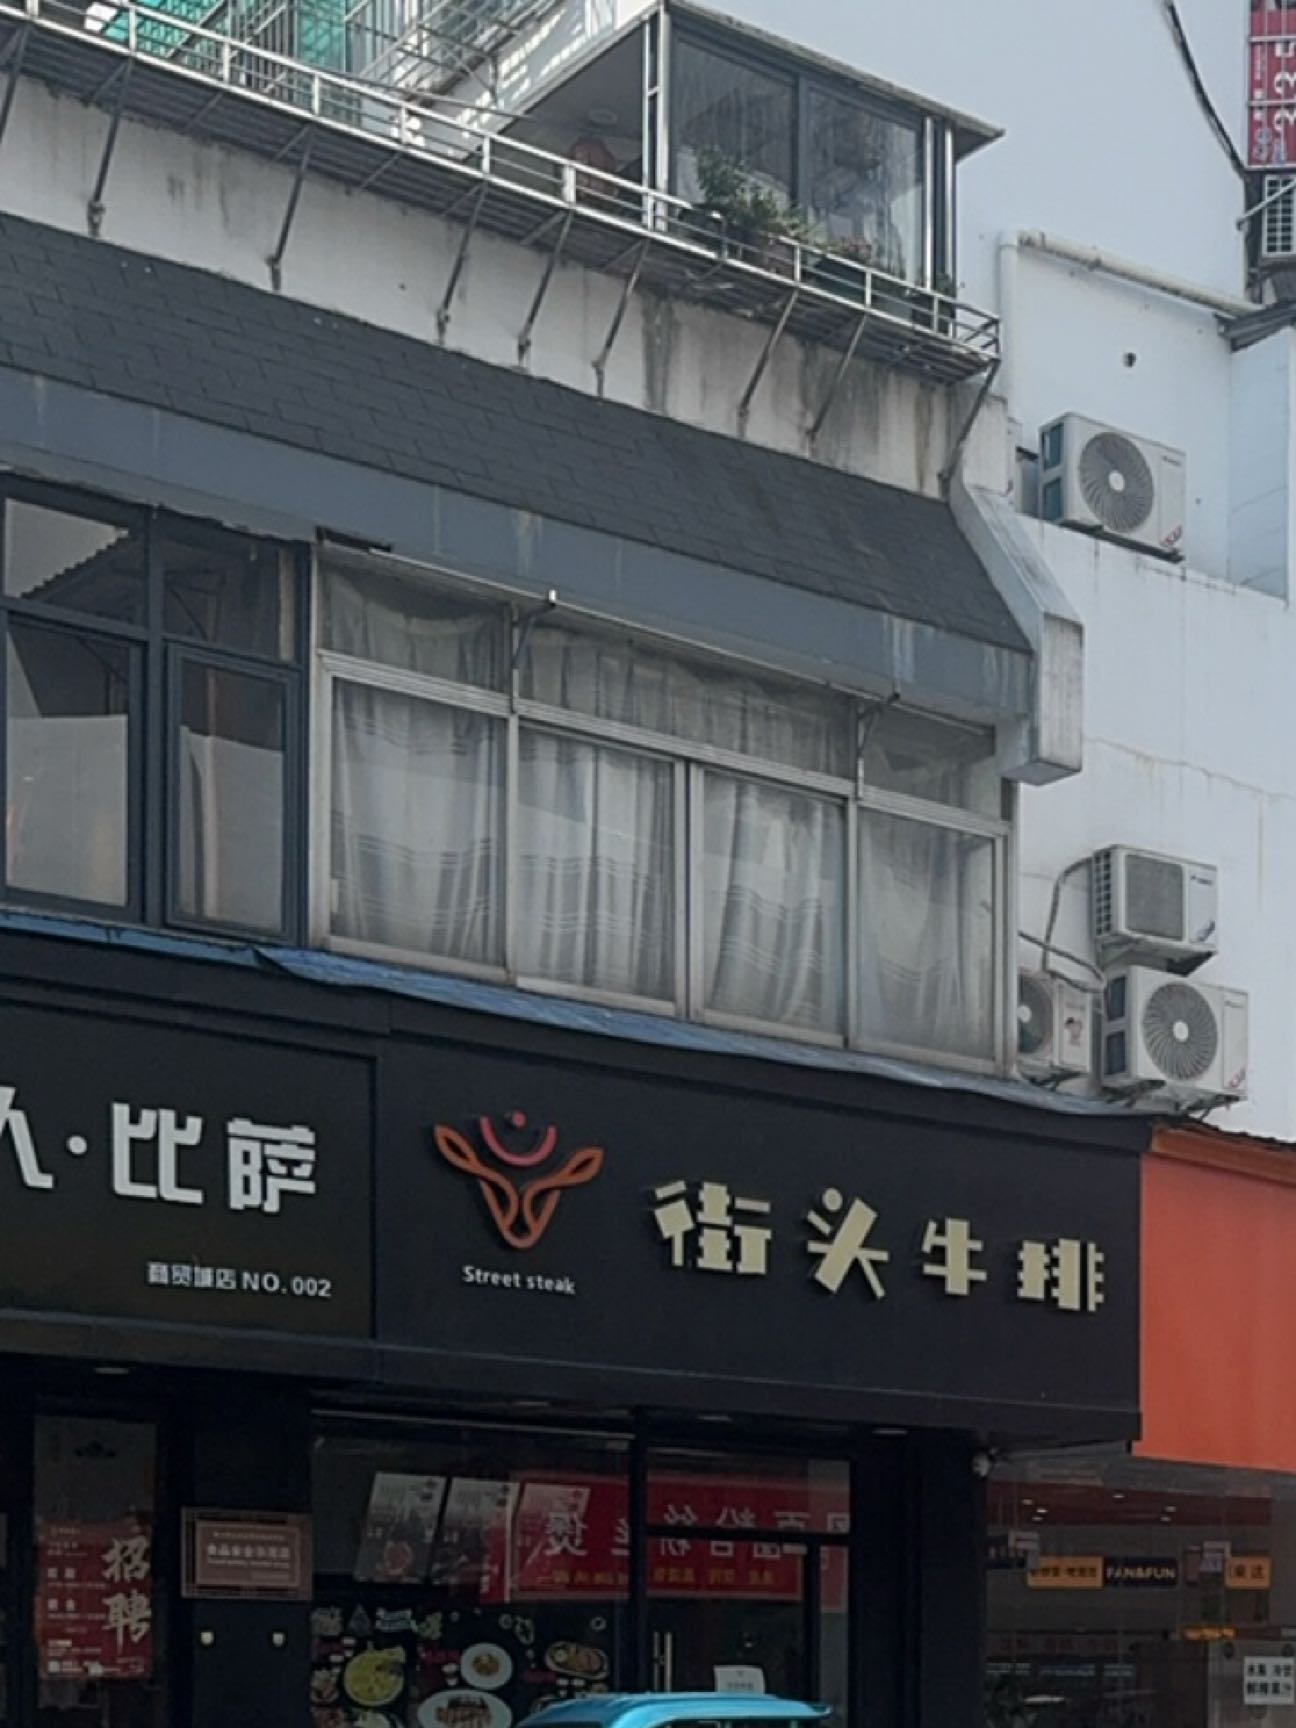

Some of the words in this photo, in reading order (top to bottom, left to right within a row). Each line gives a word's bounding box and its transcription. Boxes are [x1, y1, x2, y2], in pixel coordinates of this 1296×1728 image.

[462, 1264, 521, 1290] Street
[526, 1271, 576, 1295] steak
[653, 1180, 1104, 1312] 街头牛排
[101, 1535, 152, 1655] 招聘
[1105, 1565, 1177, 1580] FAN&FUN
